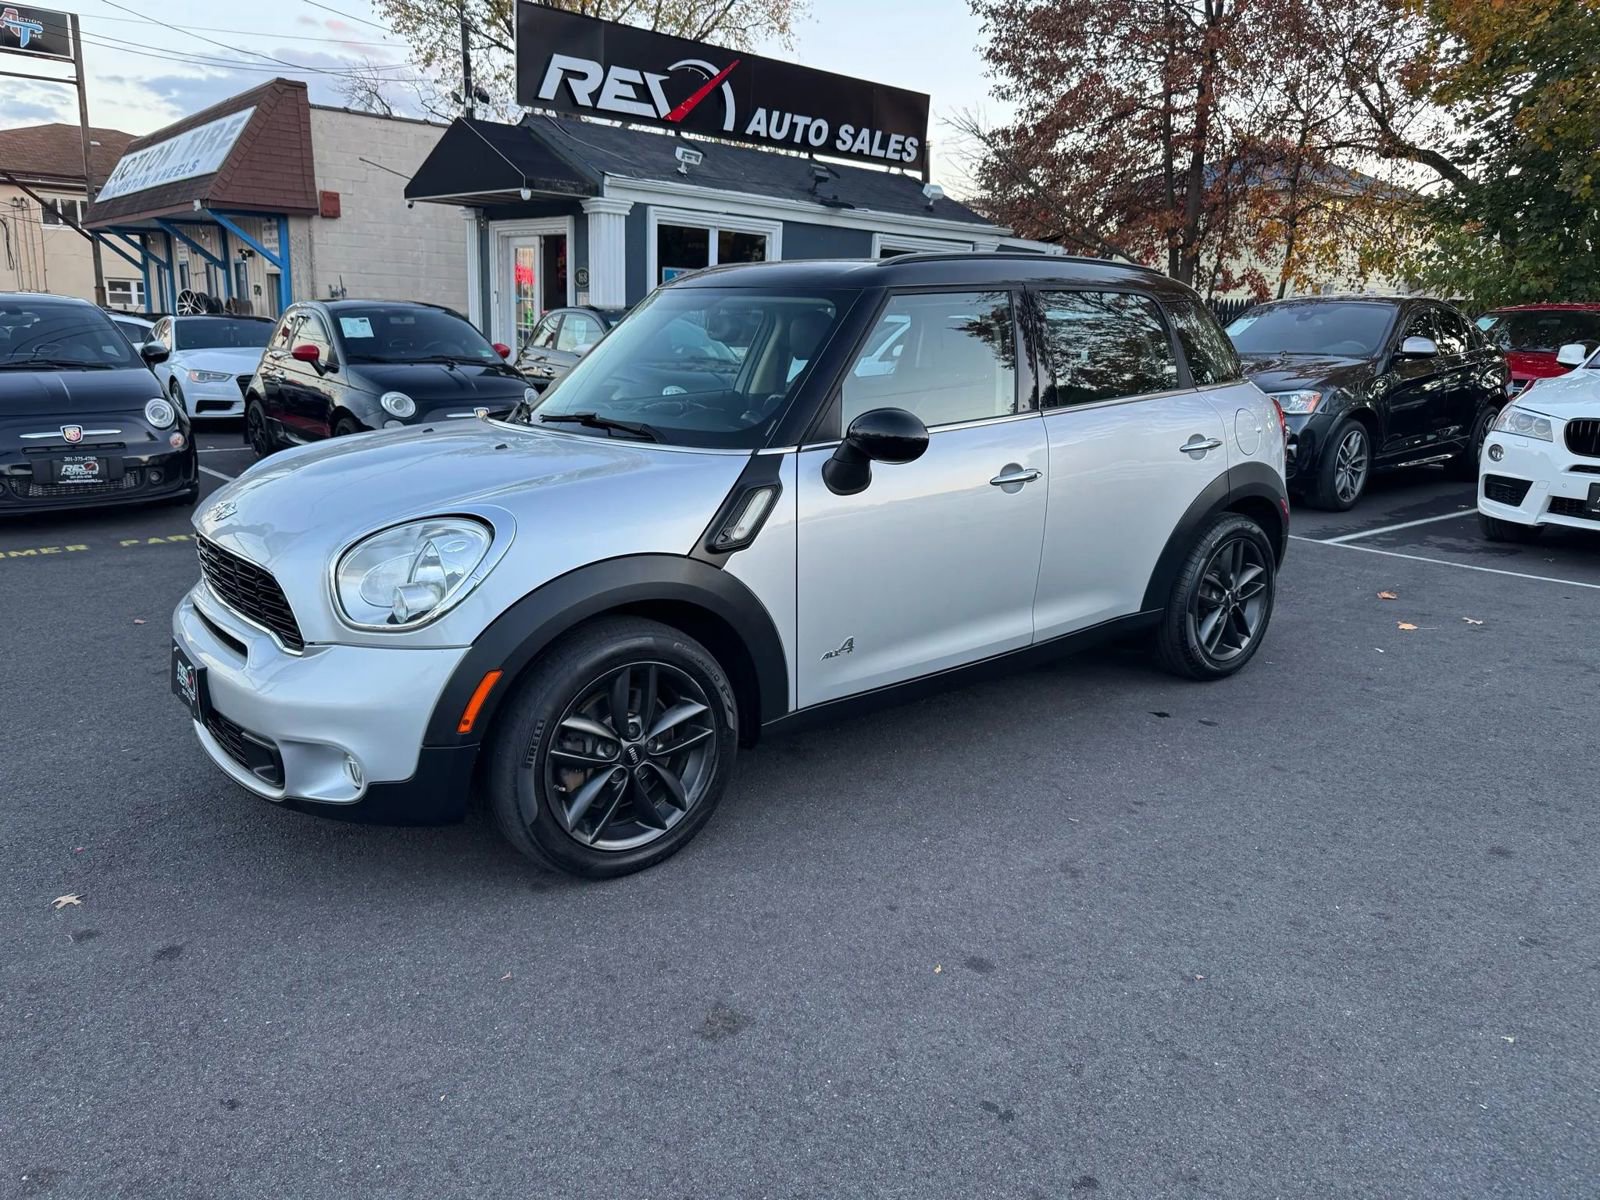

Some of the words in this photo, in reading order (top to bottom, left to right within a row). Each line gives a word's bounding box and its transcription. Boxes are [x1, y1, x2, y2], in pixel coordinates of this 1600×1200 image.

[537, 53, 740, 126] REV
[109, 139, 180, 182] ACTION
[182, 115, 247, 158] TIRE
[745, 107, 829, 147] AUTO
[836, 124, 919, 163] SALES
[119, 534, 190, 547] PAR
